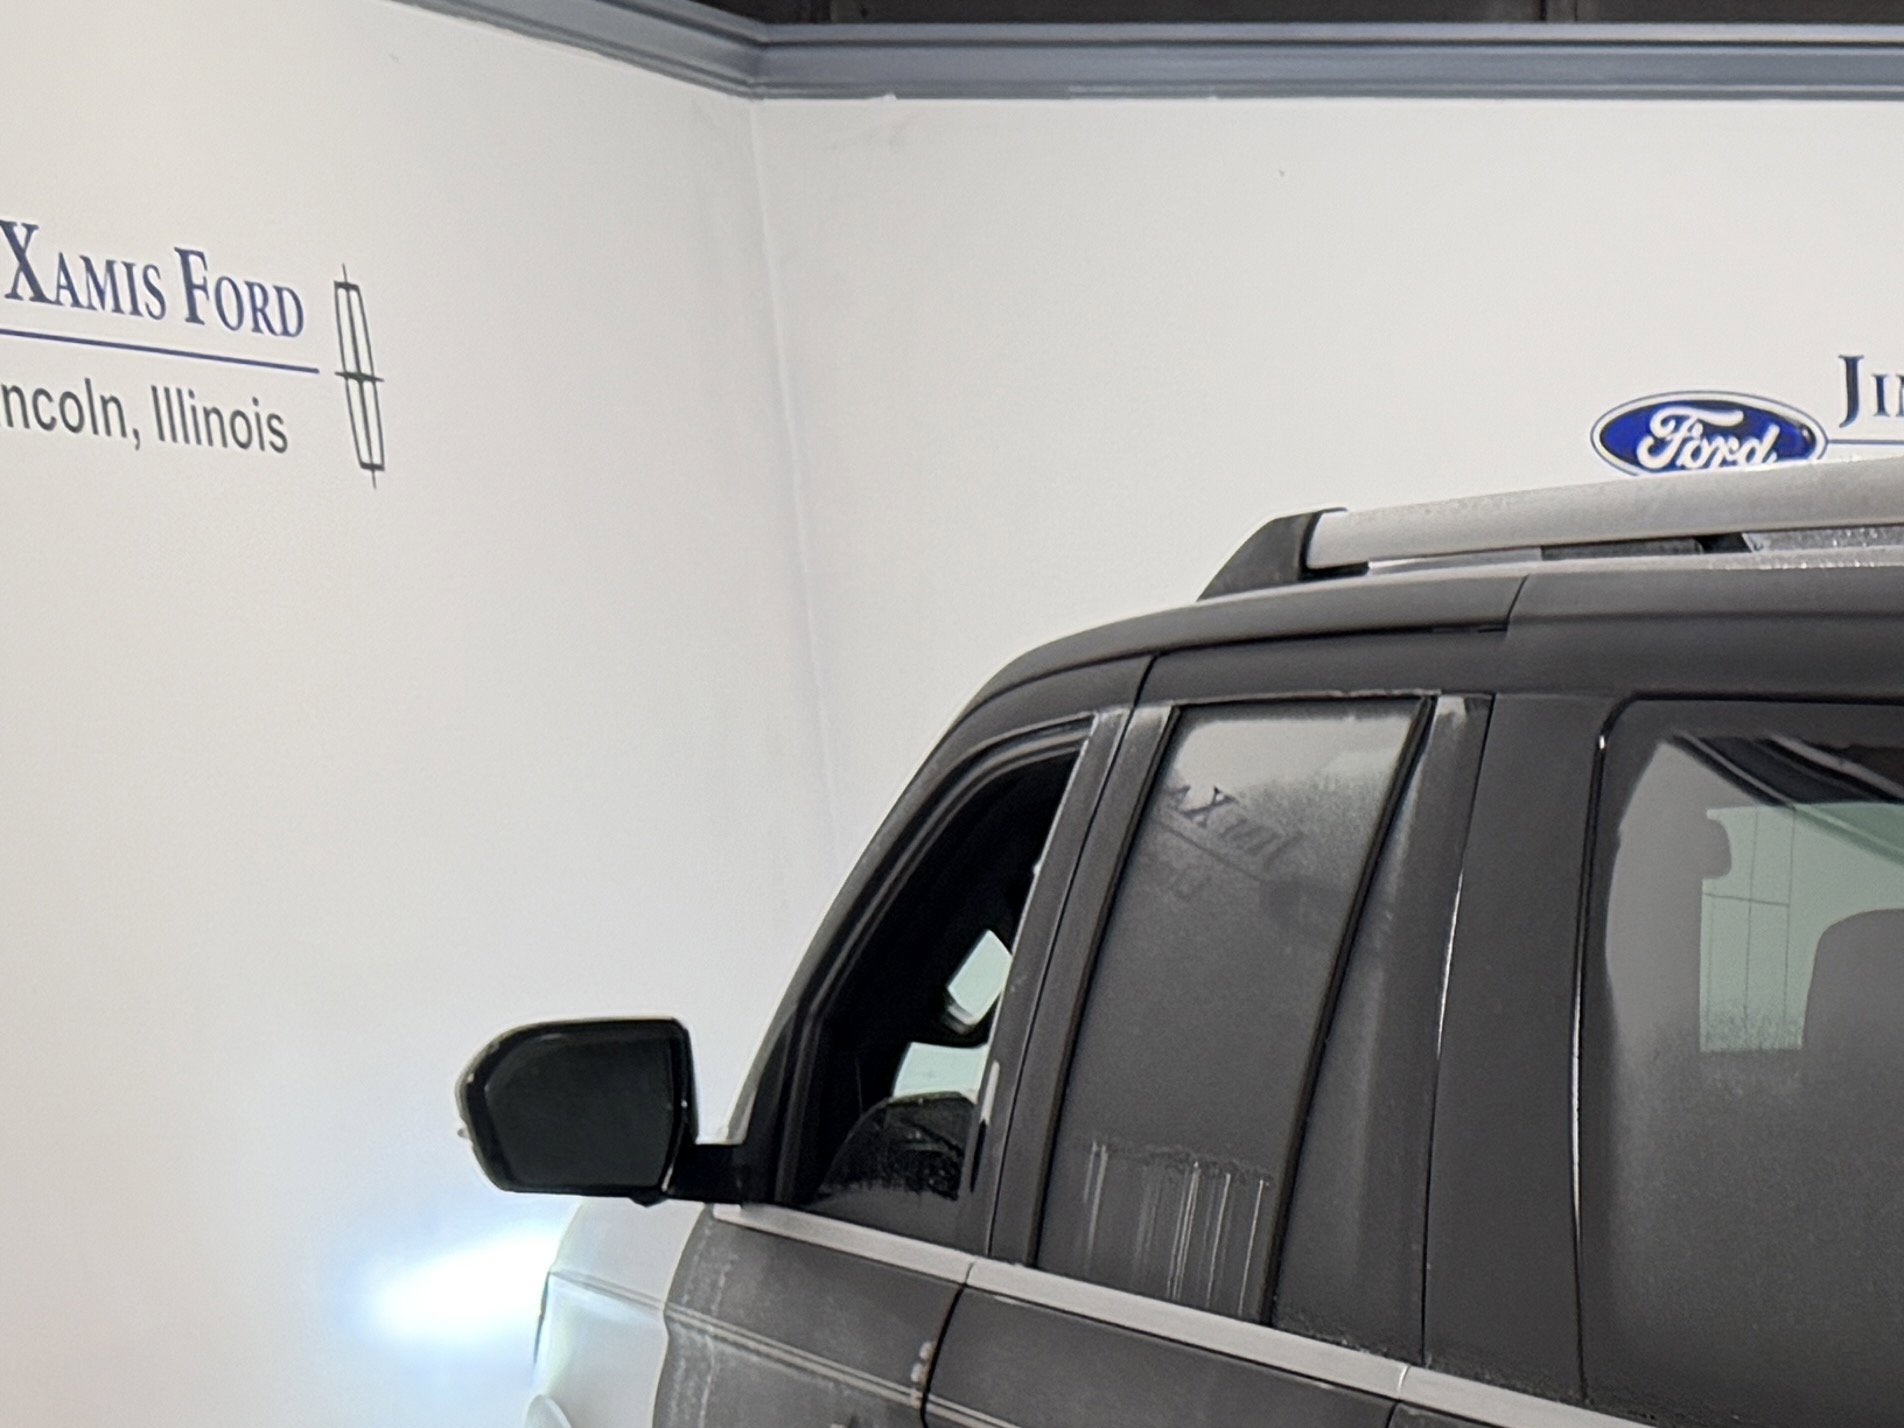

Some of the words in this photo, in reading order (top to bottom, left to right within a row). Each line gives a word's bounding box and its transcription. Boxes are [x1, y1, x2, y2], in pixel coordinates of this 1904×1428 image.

[174, 246, 304, 338] FORD
[0, 377, 141, 451] ncoln,
[150, 384, 289, 454] Illinois
[1636, 404, 1780, 470] Ford
